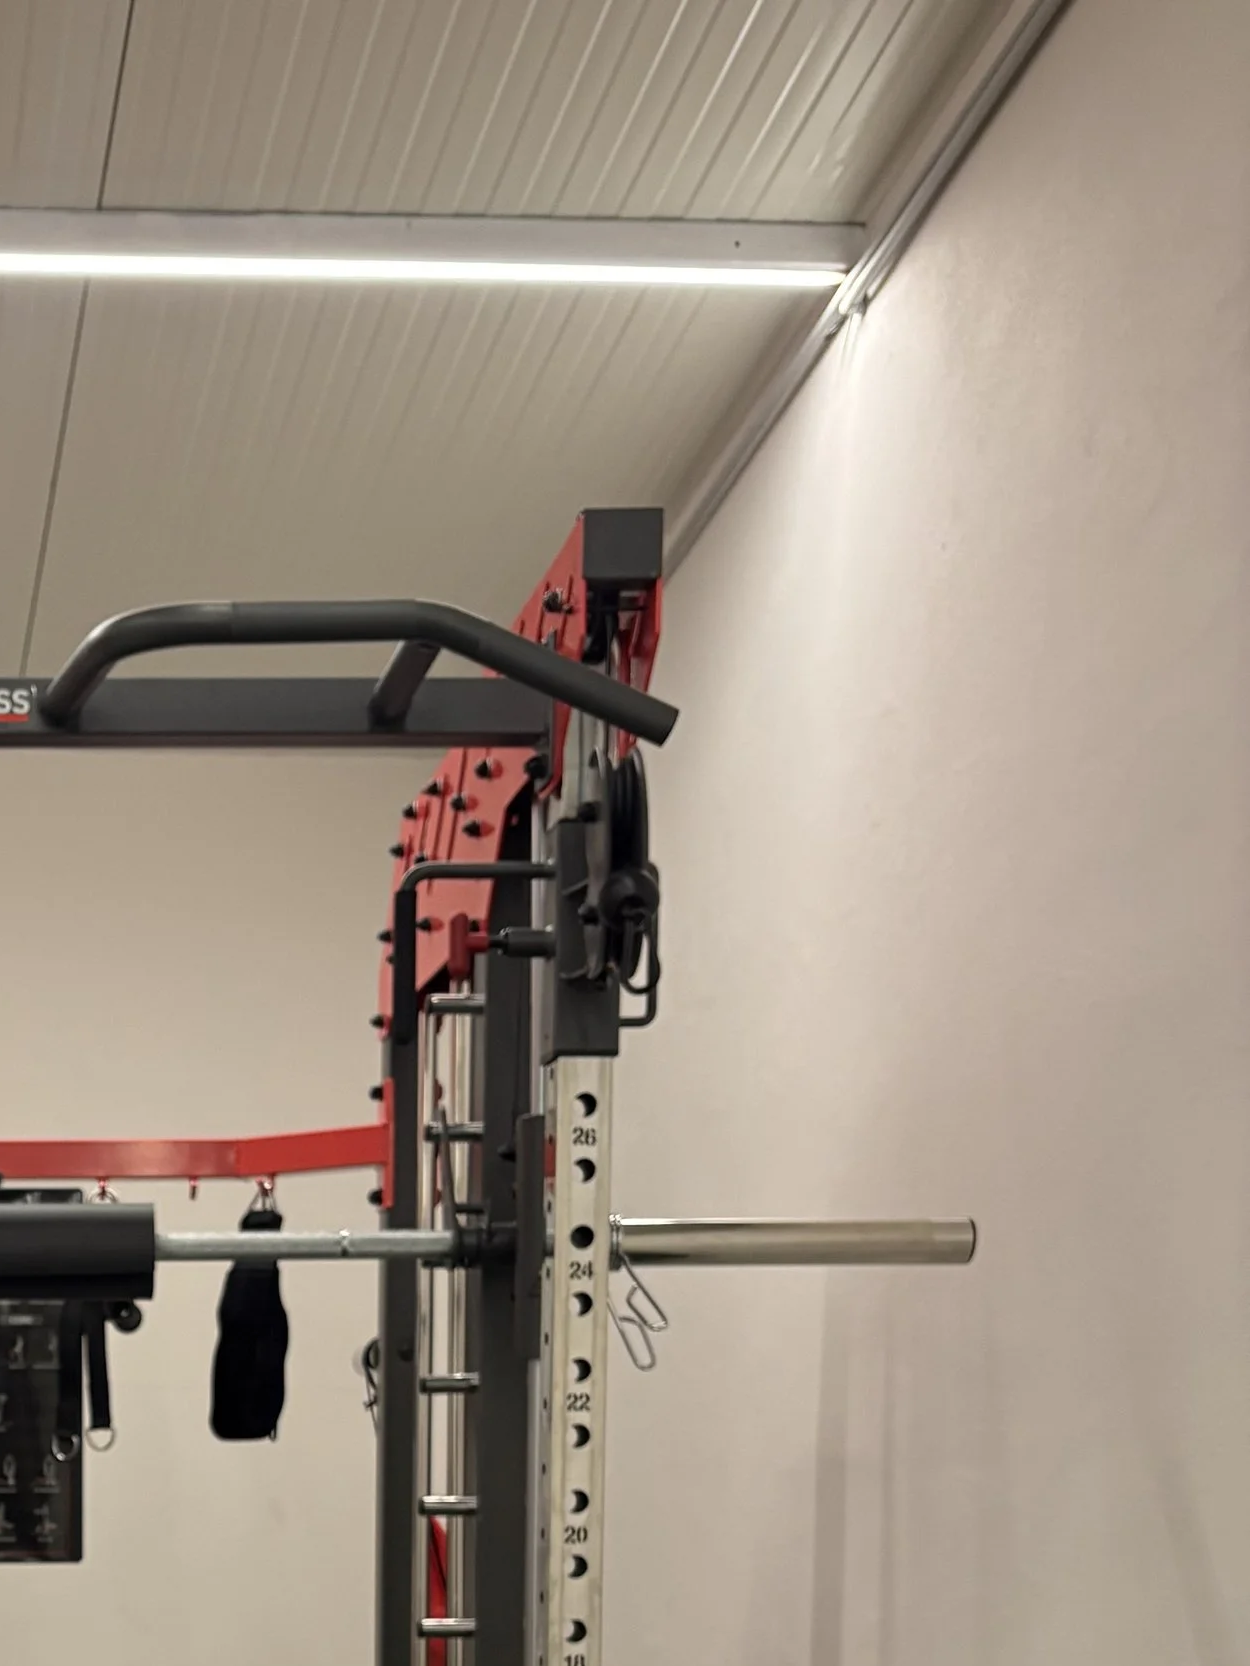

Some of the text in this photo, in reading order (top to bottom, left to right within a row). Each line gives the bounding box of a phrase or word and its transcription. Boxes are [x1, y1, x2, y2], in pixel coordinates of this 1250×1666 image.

[571, 1127, 597, 1146] 26
[568, 1261, 594, 1279] 24
[565, 1393, 591, 1411] 22
[563, 1526, 588, 1544] 20
